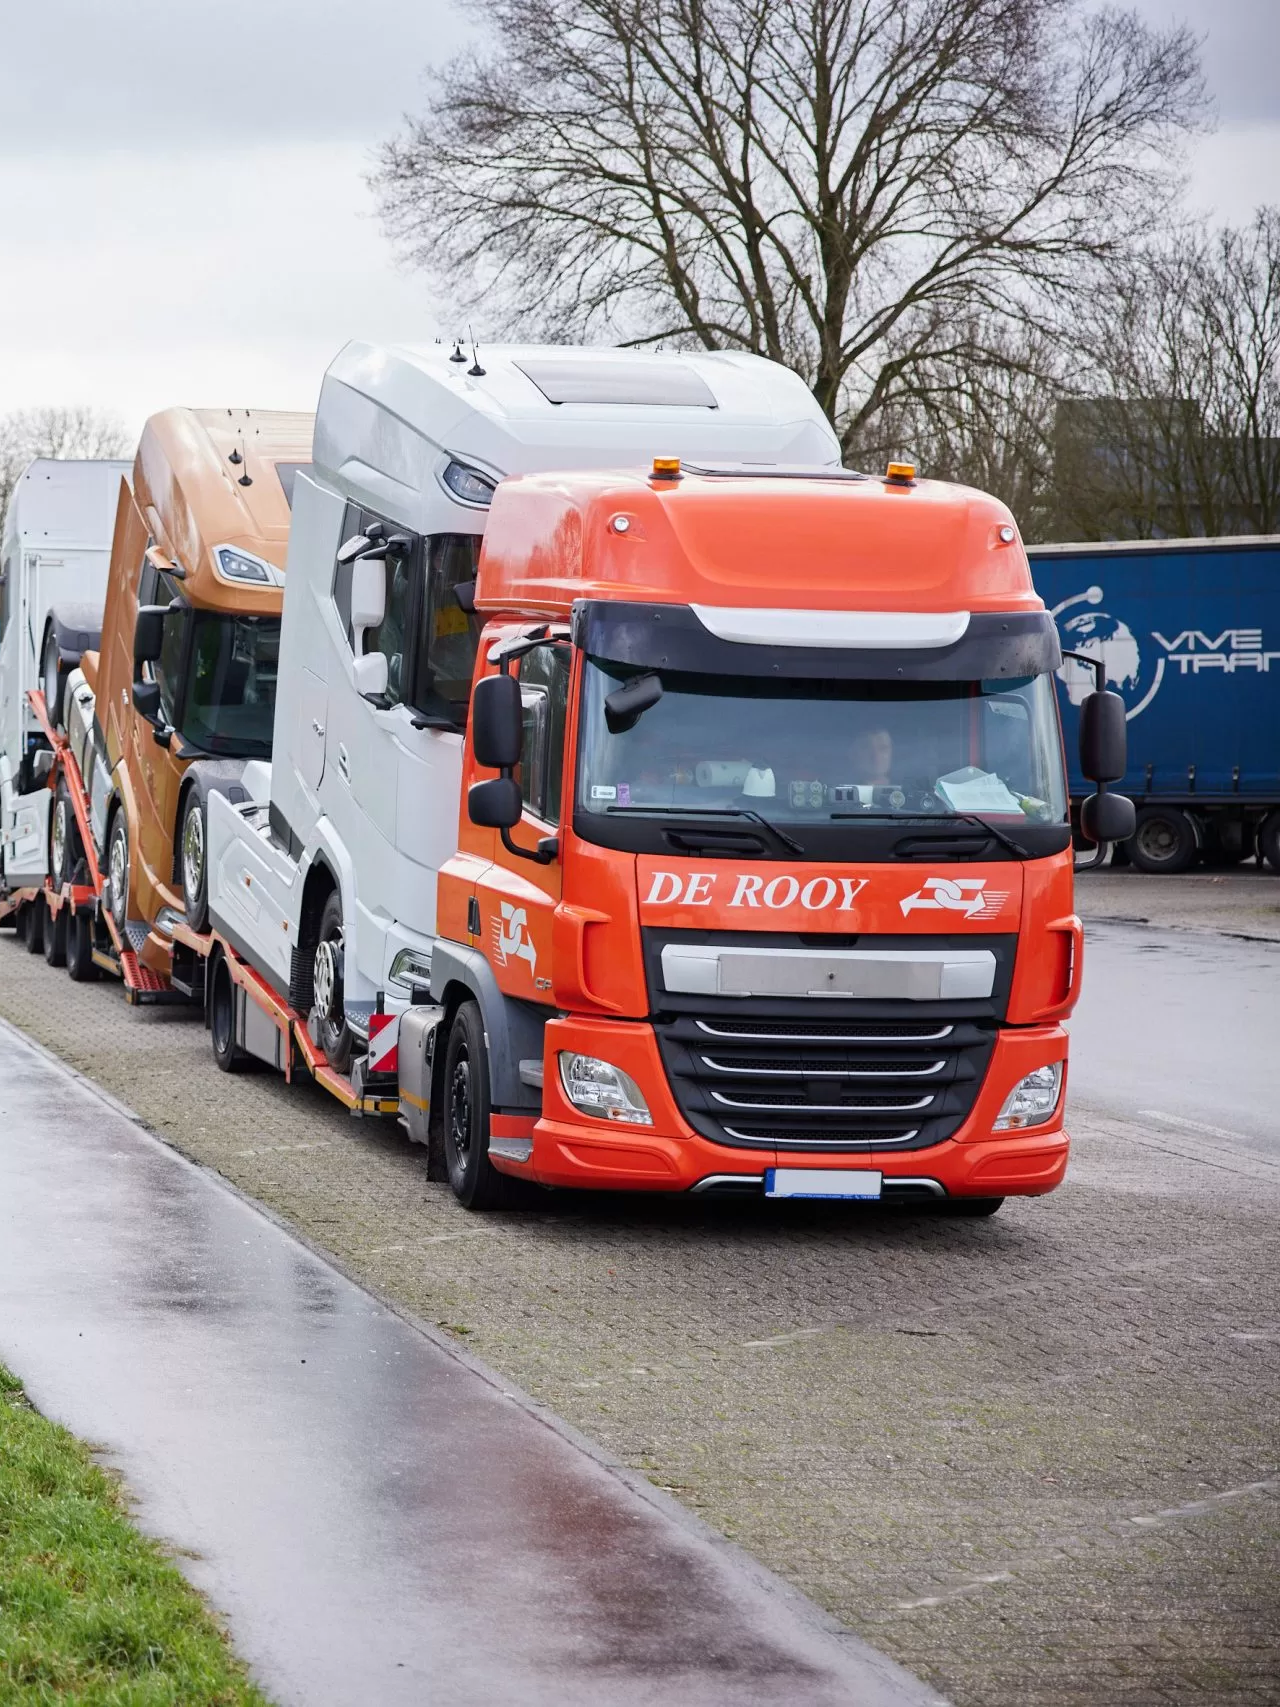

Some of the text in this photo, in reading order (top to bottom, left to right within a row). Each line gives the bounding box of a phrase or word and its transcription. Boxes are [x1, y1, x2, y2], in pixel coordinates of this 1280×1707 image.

[1151, 629, 1262, 651] VIVE
[642, 872, 869, 911] DE ROOY
